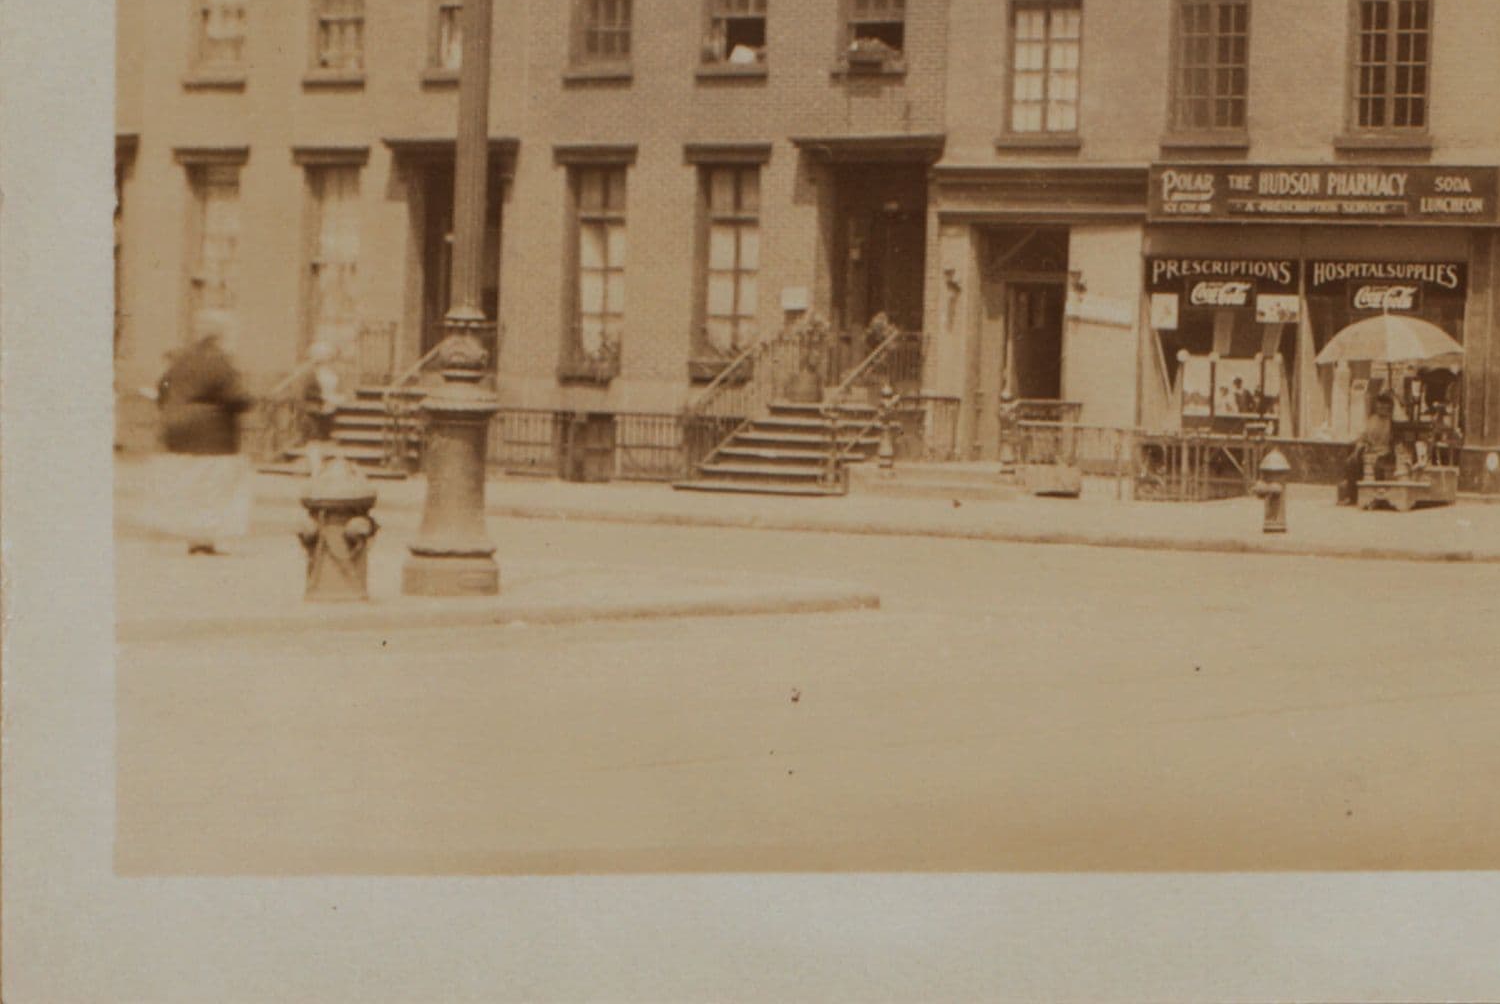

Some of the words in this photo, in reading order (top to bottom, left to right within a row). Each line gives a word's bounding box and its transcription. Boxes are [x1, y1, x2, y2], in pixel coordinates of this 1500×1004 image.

[1162, 170, 1215, 201] POLAR
[1228, 174, 1251, 191] THE
[1258, 171, 1320, 195] HUDSON
[1327, 172, 1408, 196] PHARMACY
[1434, 176, 1472, 193] SODA
[1420, 197, 1484, 214] LUNCHEON
[1153, 259, 1291, 284] PRESCRIPTIONS
